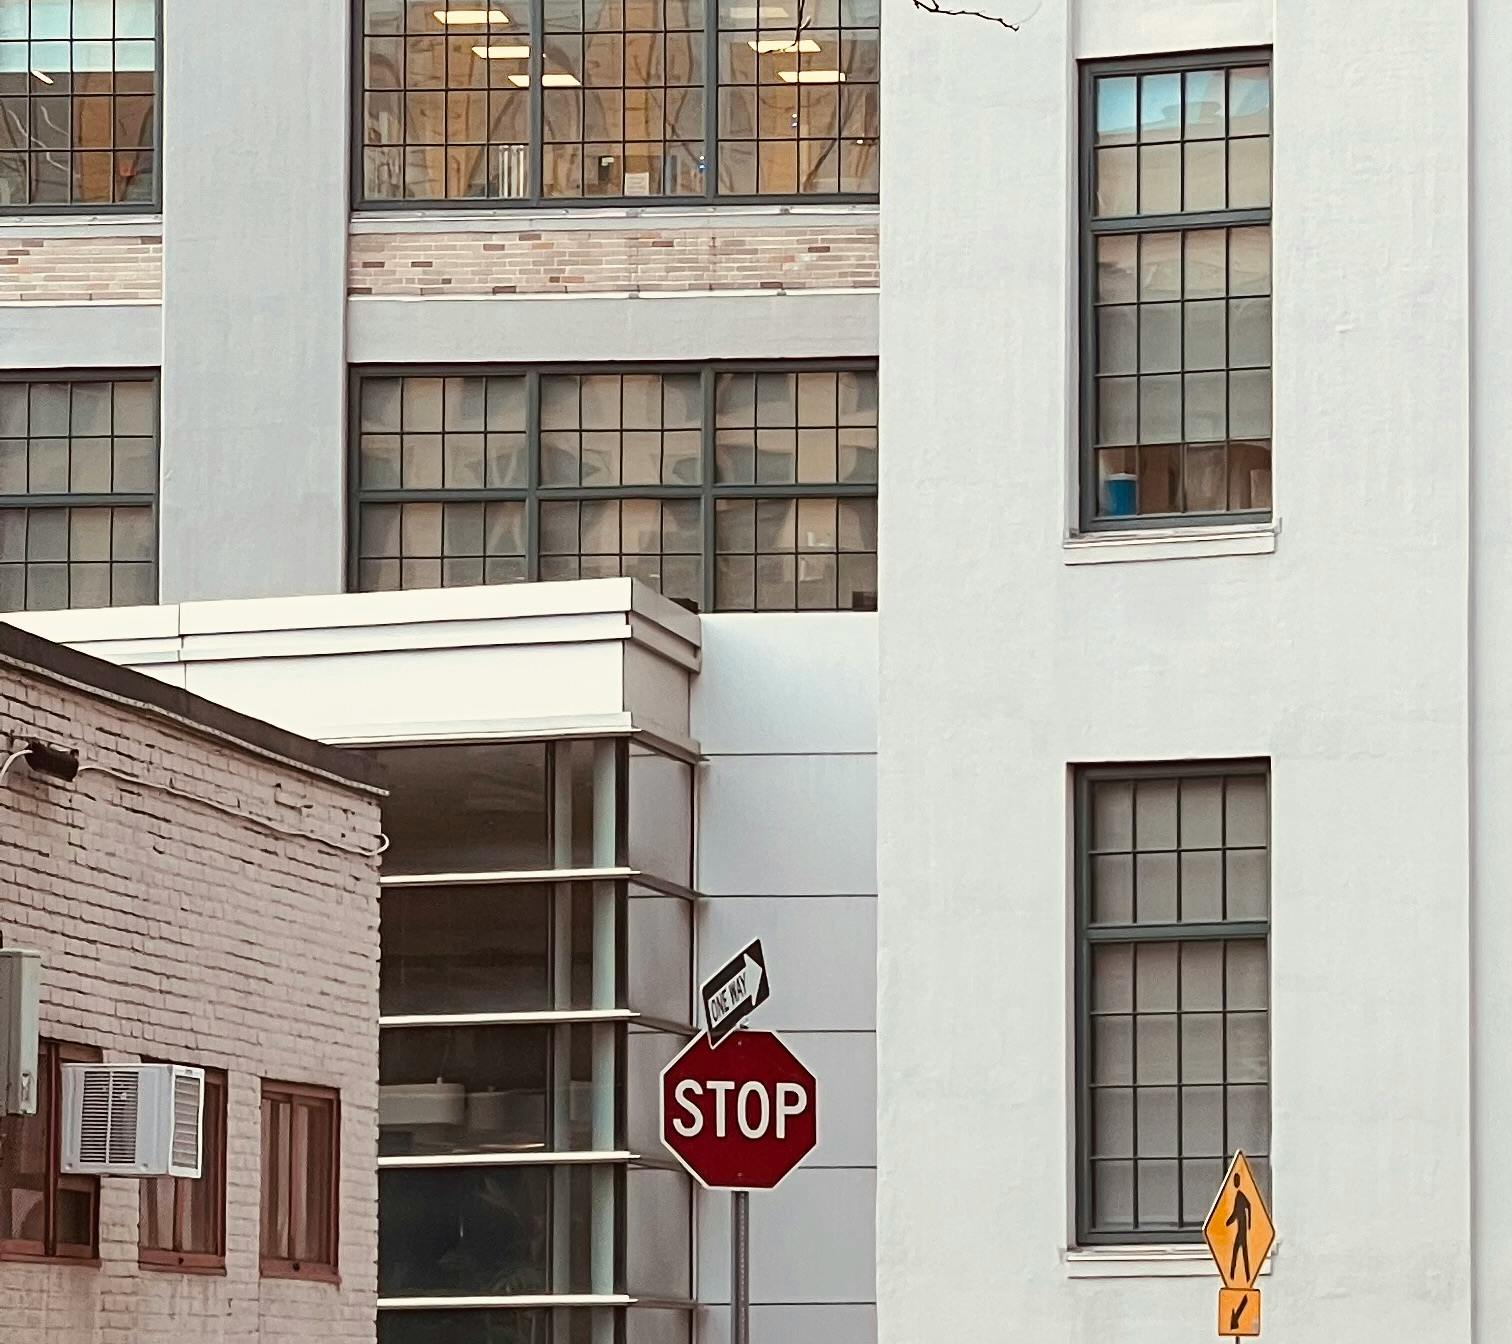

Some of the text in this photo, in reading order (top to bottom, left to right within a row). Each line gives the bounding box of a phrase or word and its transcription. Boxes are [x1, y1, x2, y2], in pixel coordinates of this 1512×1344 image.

[710, 971, 748, 1023] ONE WAY
[672, 1079, 808, 1139] STOP
